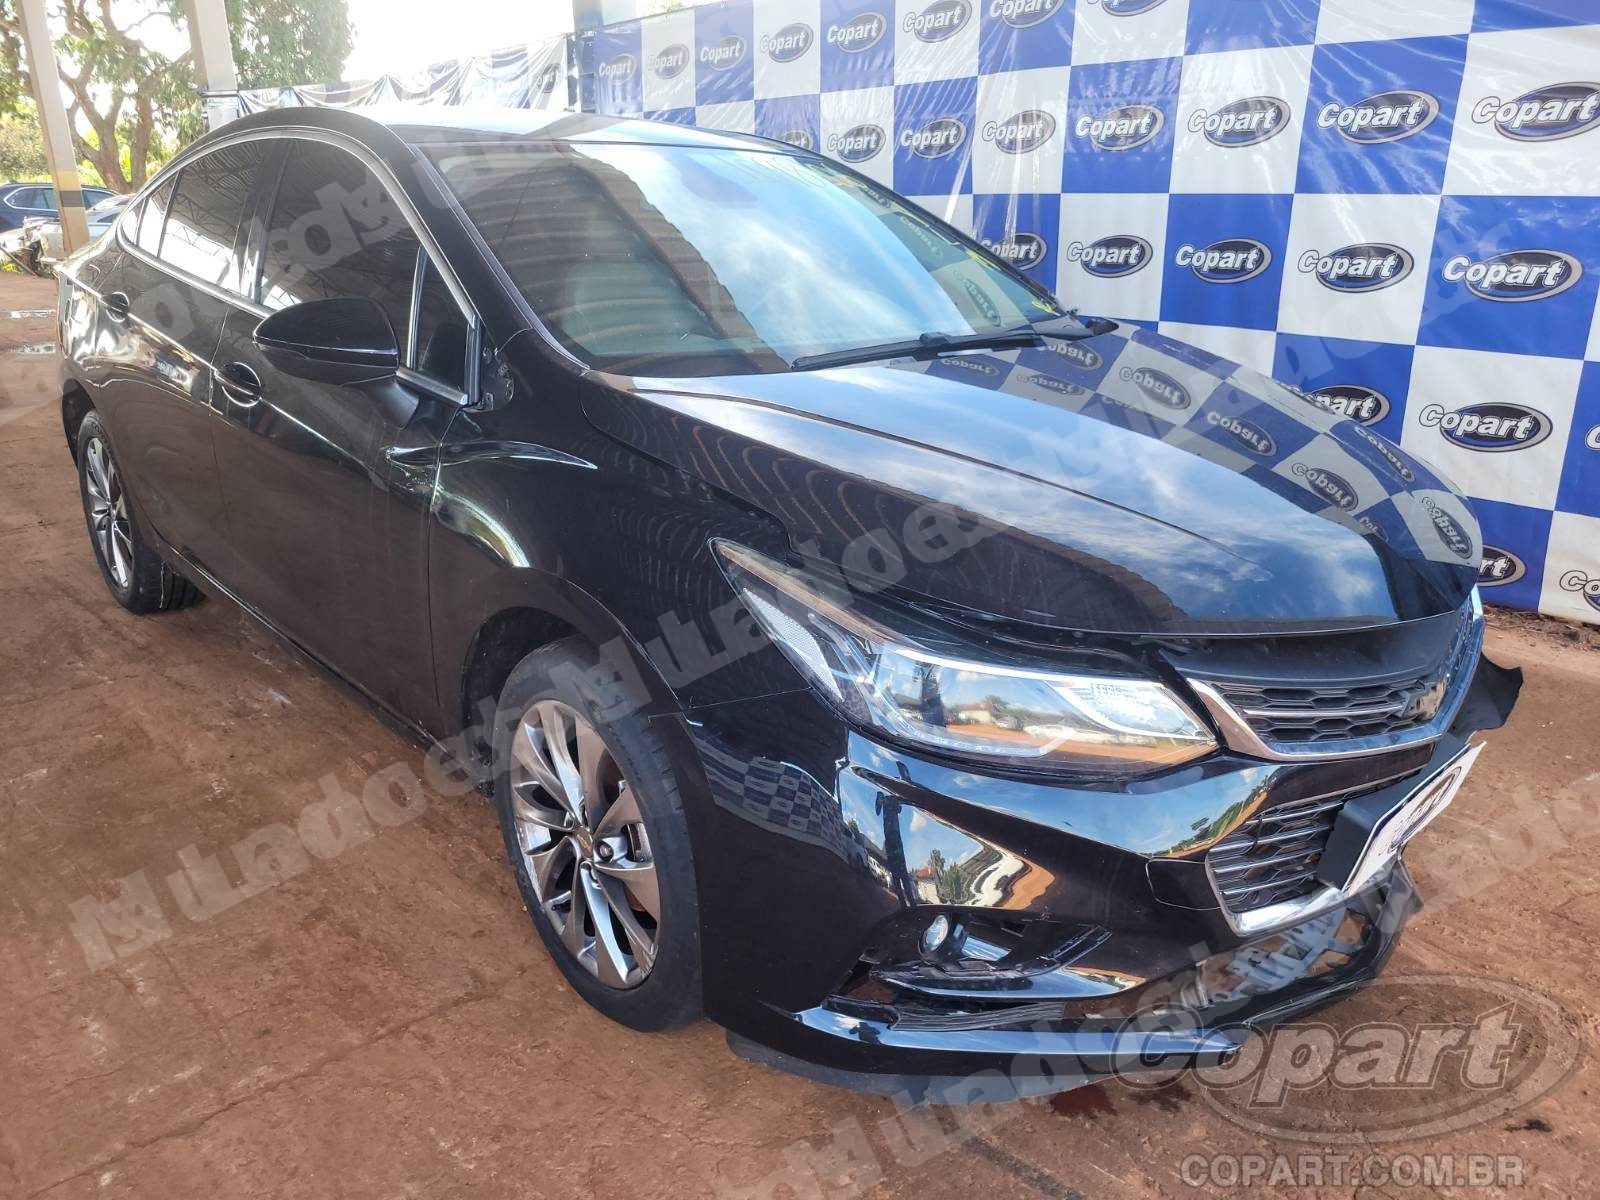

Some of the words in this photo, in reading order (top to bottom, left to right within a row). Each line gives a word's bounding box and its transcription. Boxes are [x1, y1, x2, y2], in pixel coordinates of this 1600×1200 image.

[827, 17, 879, 45] Copart
[903, 4, 962, 34] Copart
[700, 38, 741, 62] Copart
[760, 28, 806, 53] Copart
[599, 61, 632, 79] Copart
[648, 51, 684, 70] Copart
[1187, 104, 1278, 138] Copart
[1317, 98, 1424, 136] Copart
[1471, 92, 1600, 131] Copart
[900, 127, 958, 152] Copart
[982, 119, 1044, 148] Copart
[1075, 112, 1152, 142] Copart
[827, 131, 878, 153] Copart
[1066, 241, 1141, 268] Copart
[1175, 243, 1261, 273] Copart
[1297, 249, 1398, 281] Copart
[1442, 255, 1565, 289] Copart
[1419, 404, 1535, 440] Copart
